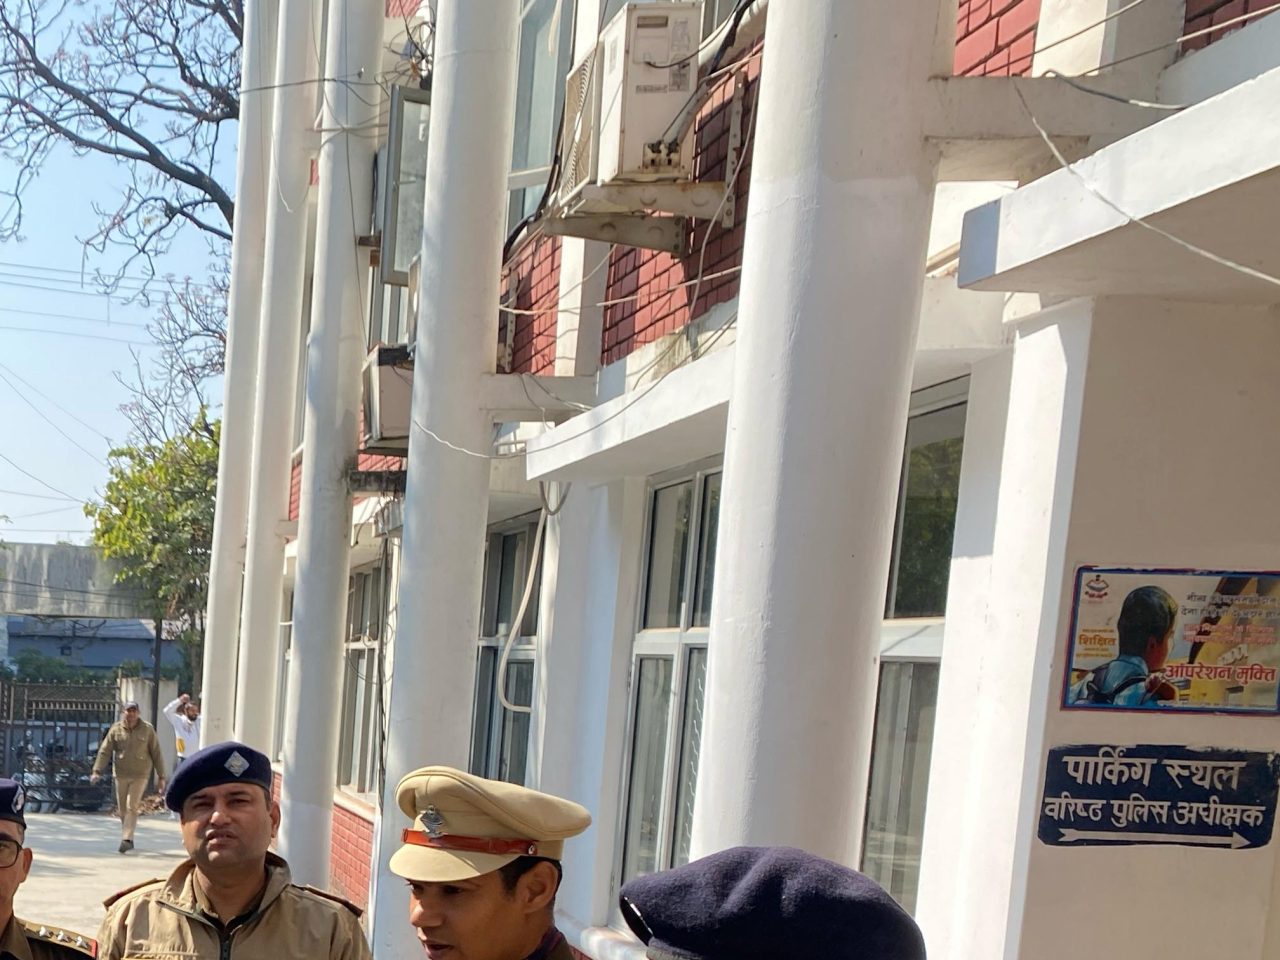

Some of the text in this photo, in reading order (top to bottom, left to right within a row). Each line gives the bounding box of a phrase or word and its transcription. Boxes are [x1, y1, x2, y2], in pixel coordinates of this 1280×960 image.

[1237, 663, 1276, 685] मुक्ति
[1062, 746, 1248, 791] पार्किंग स्थल
[1110, 793, 1172, 828] पुलिस
